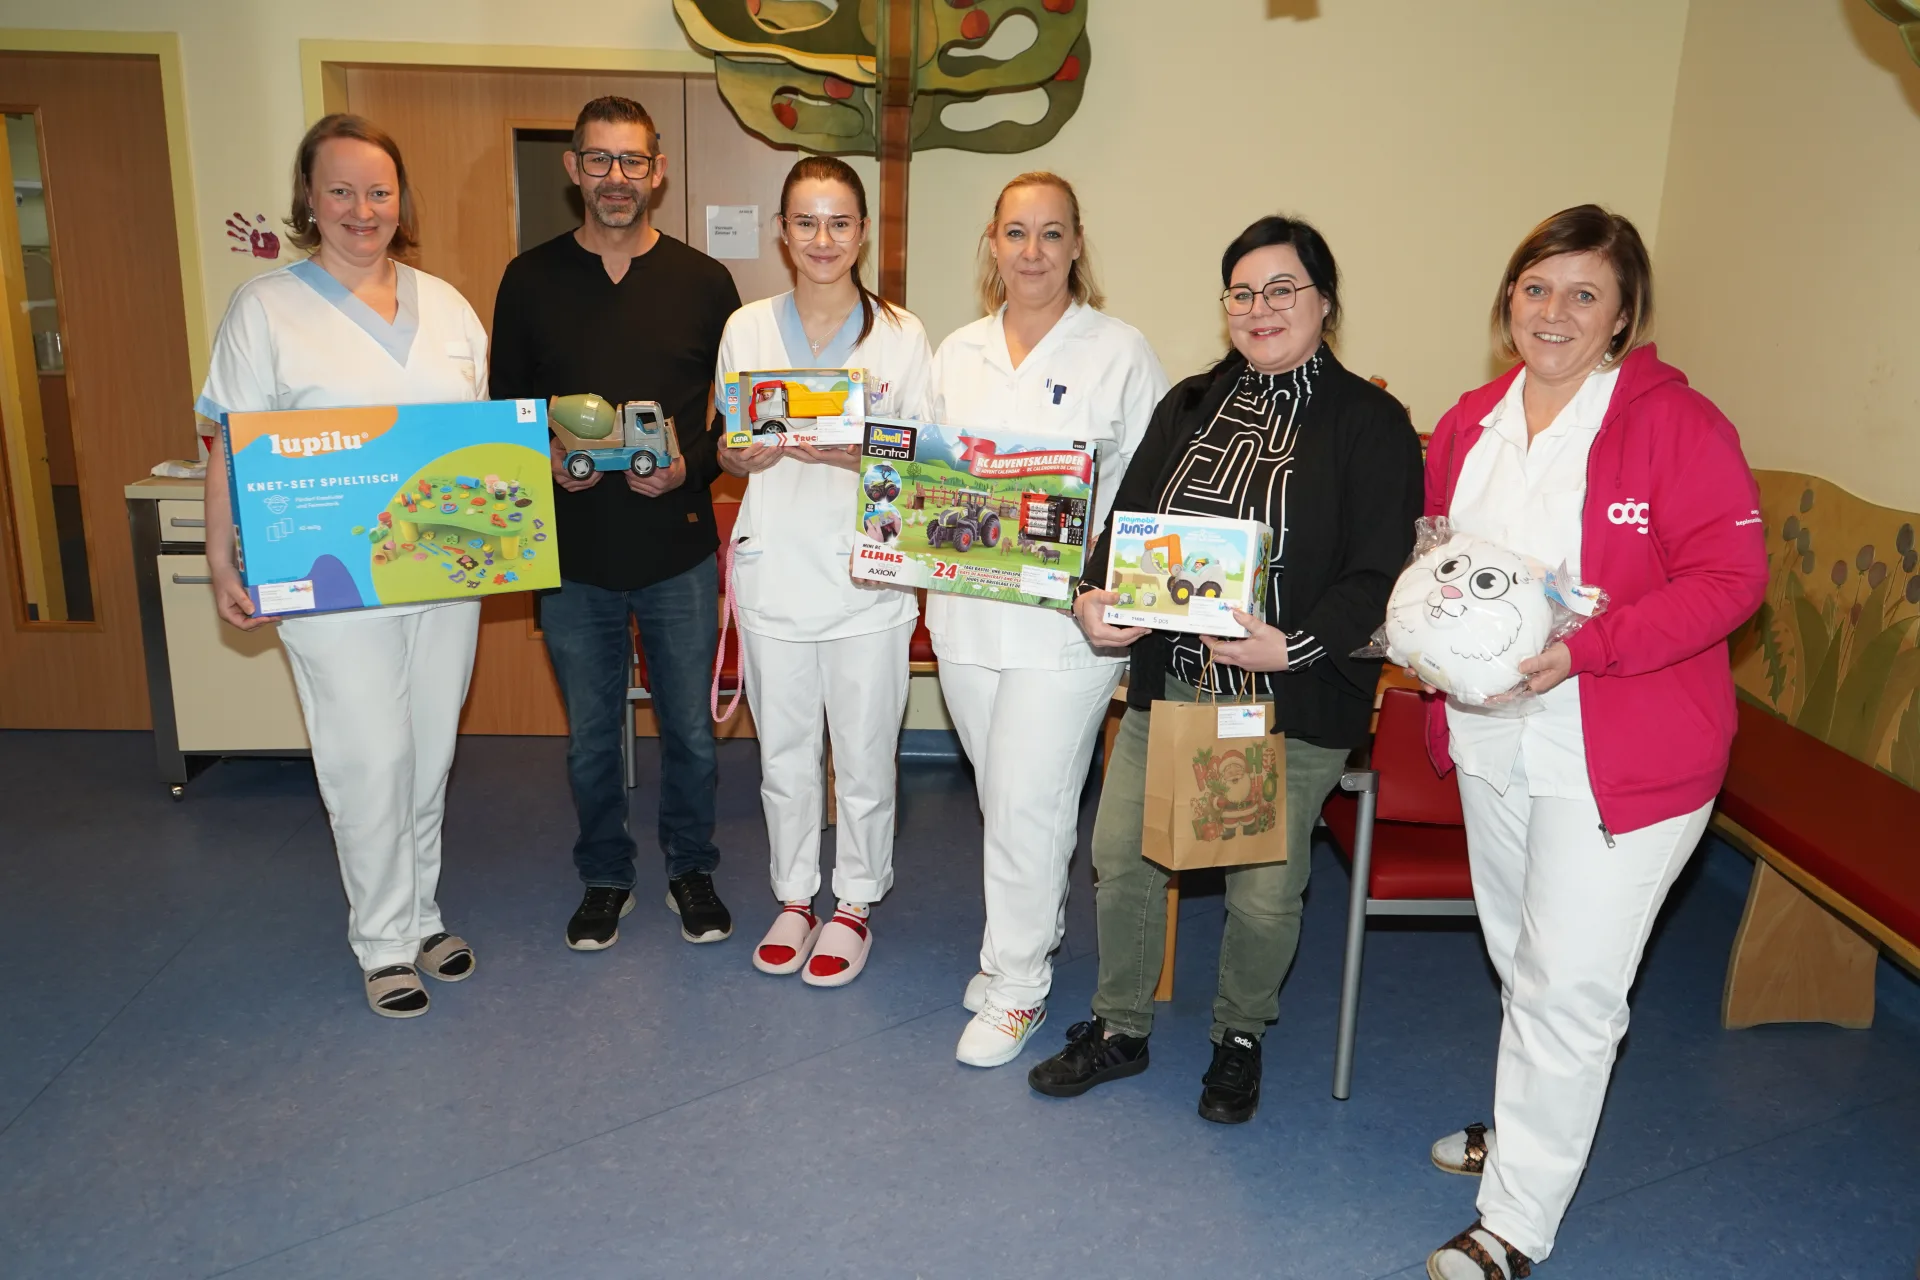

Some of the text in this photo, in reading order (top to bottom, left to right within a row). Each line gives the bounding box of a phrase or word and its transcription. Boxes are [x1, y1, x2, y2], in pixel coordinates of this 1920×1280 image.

[521, 407, 531, 415] 3+
[793, 434, 818, 442] TRUC
[873, 428, 901, 443] Revell
[269, 431, 362, 456] lupilu
[868, 445, 909, 459] Control
[977, 454, 1085, 469] RC ADVENTSKALENDER
[247, 473, 399, 492] KNET-SET SPIELTISCH
[860, 549, 904, 563] CLAAS
[868, 568, 897, 577] AXION
[932, 562, 958, 579] 24
